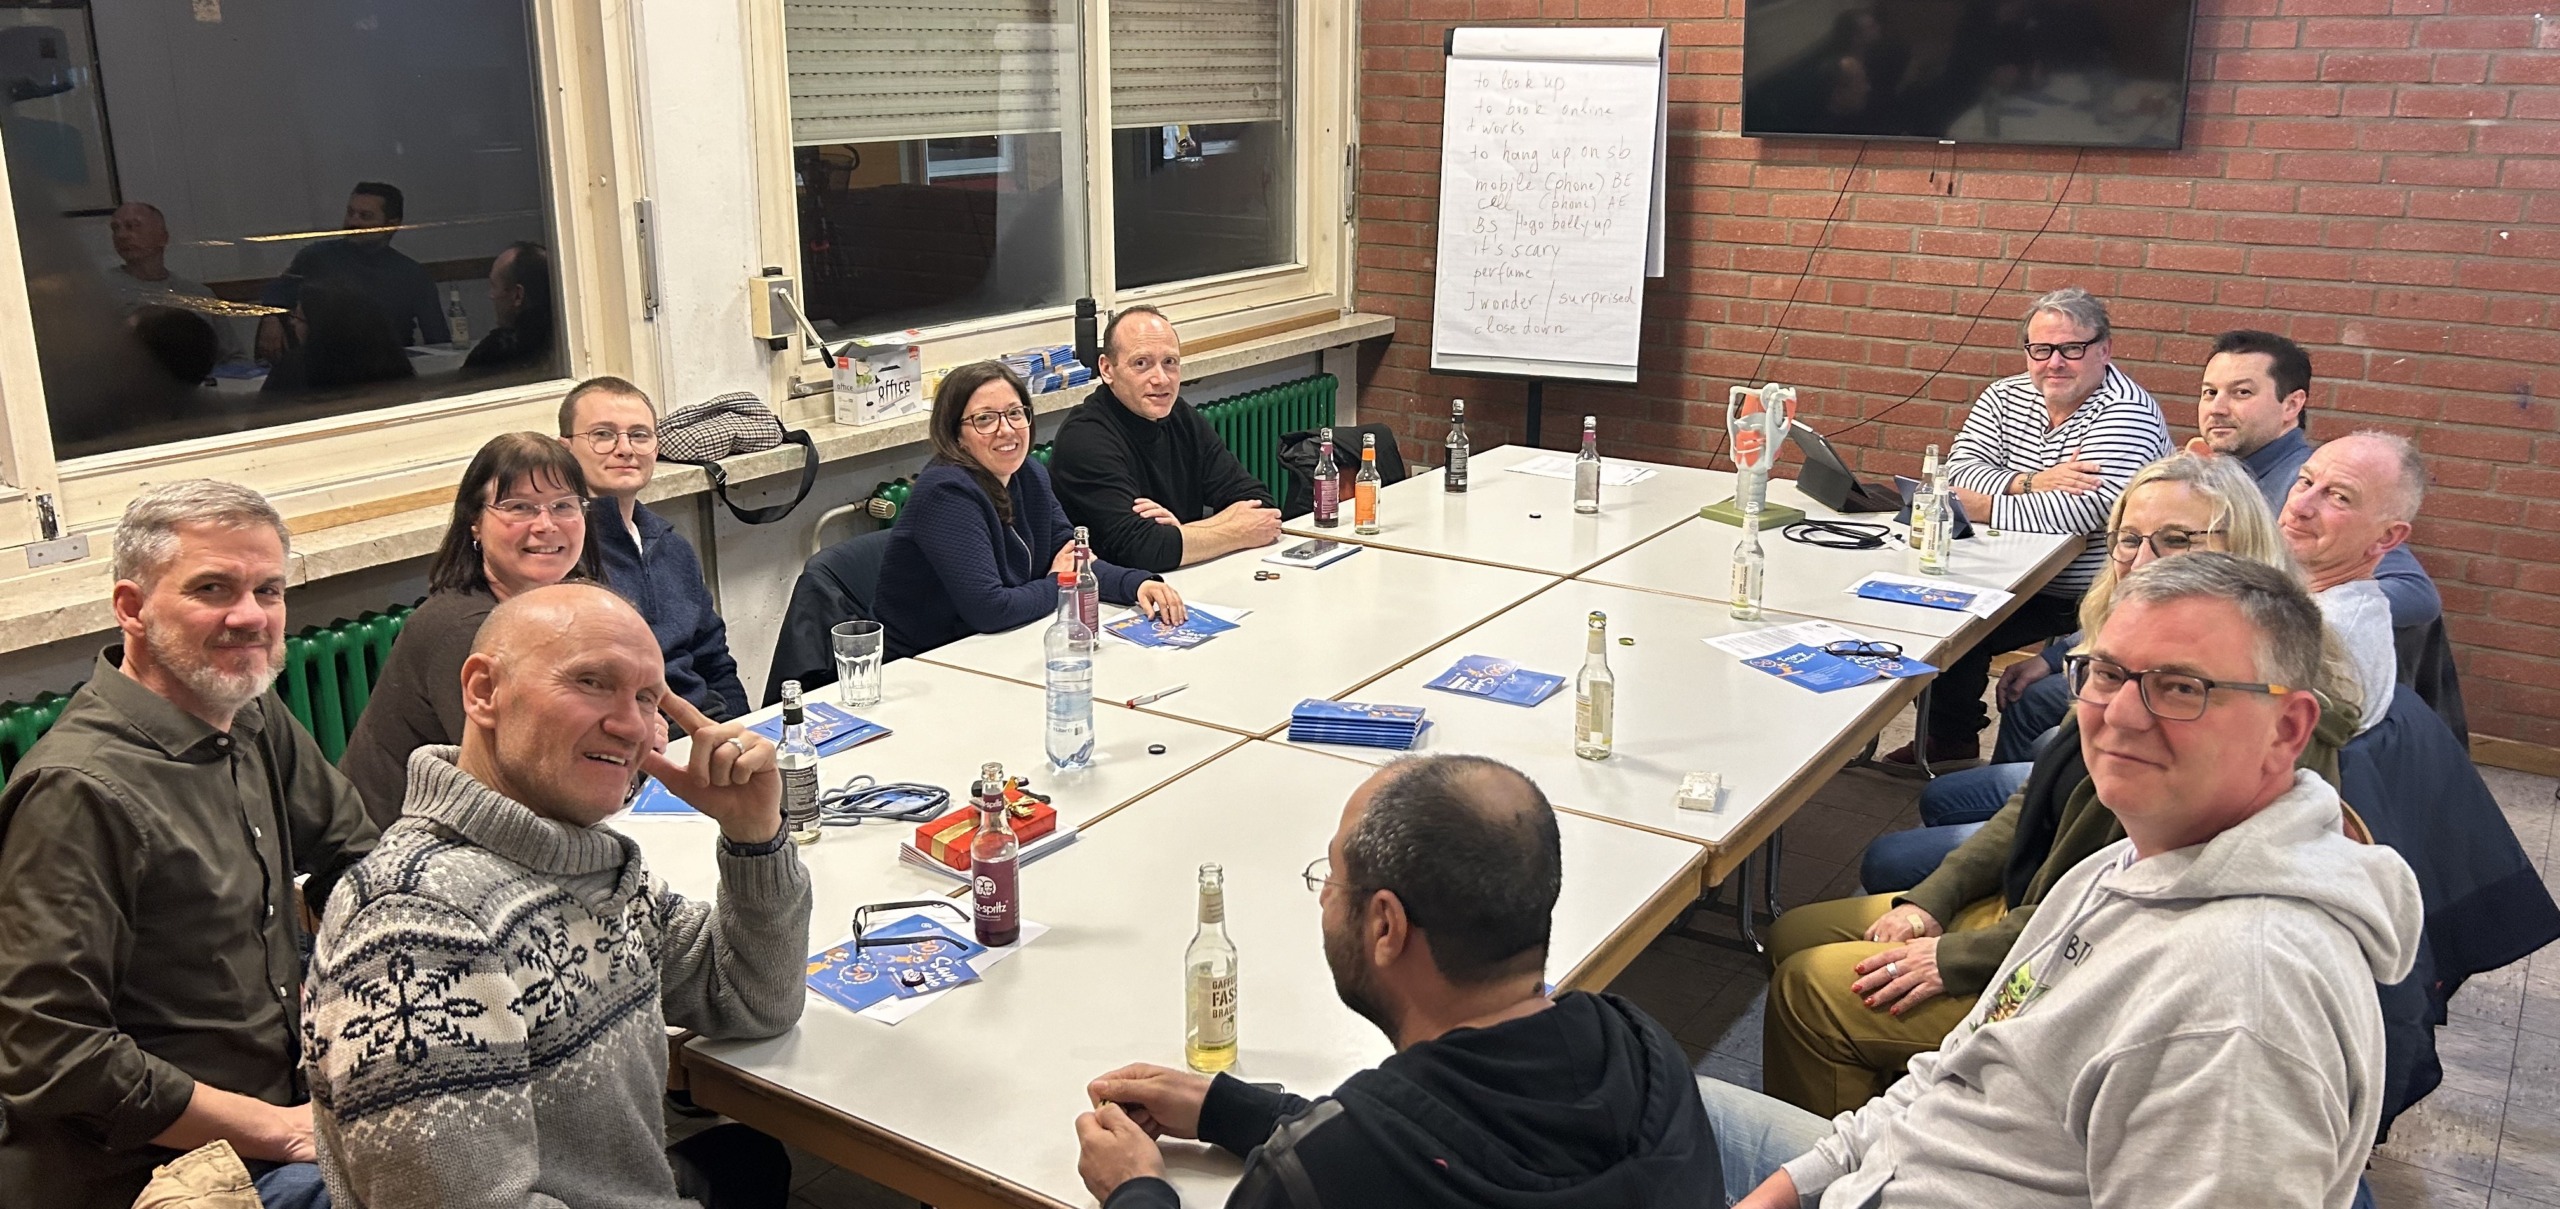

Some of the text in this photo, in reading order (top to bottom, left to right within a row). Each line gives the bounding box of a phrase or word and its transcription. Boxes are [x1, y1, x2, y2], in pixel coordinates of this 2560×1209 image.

[1473, 69, 1565, 103] to look up
[1474, 97, 1614, 117] to book online
[1482, 119, 1525, 135] works
[1469, 135, 1631, 174] to hang up on sb
[1475, 171, 1634, 200] mobile (phone) BE
[1607, 193, 1631, 211] AE
[1472, 215, 1498, 234] BS
[1594, 218, 1612, 237] up
[1511, 243, 1561, 277] scary
[1473, 261, 1534, 286] perfume
[1480, 289, 1539, 311] wonder
[1558, 285, 1637, 313] surprised
[1474, 315, 1568, 335] close down
[878, 378, 911, 399] office
[930, 956, 959, 982] Save
